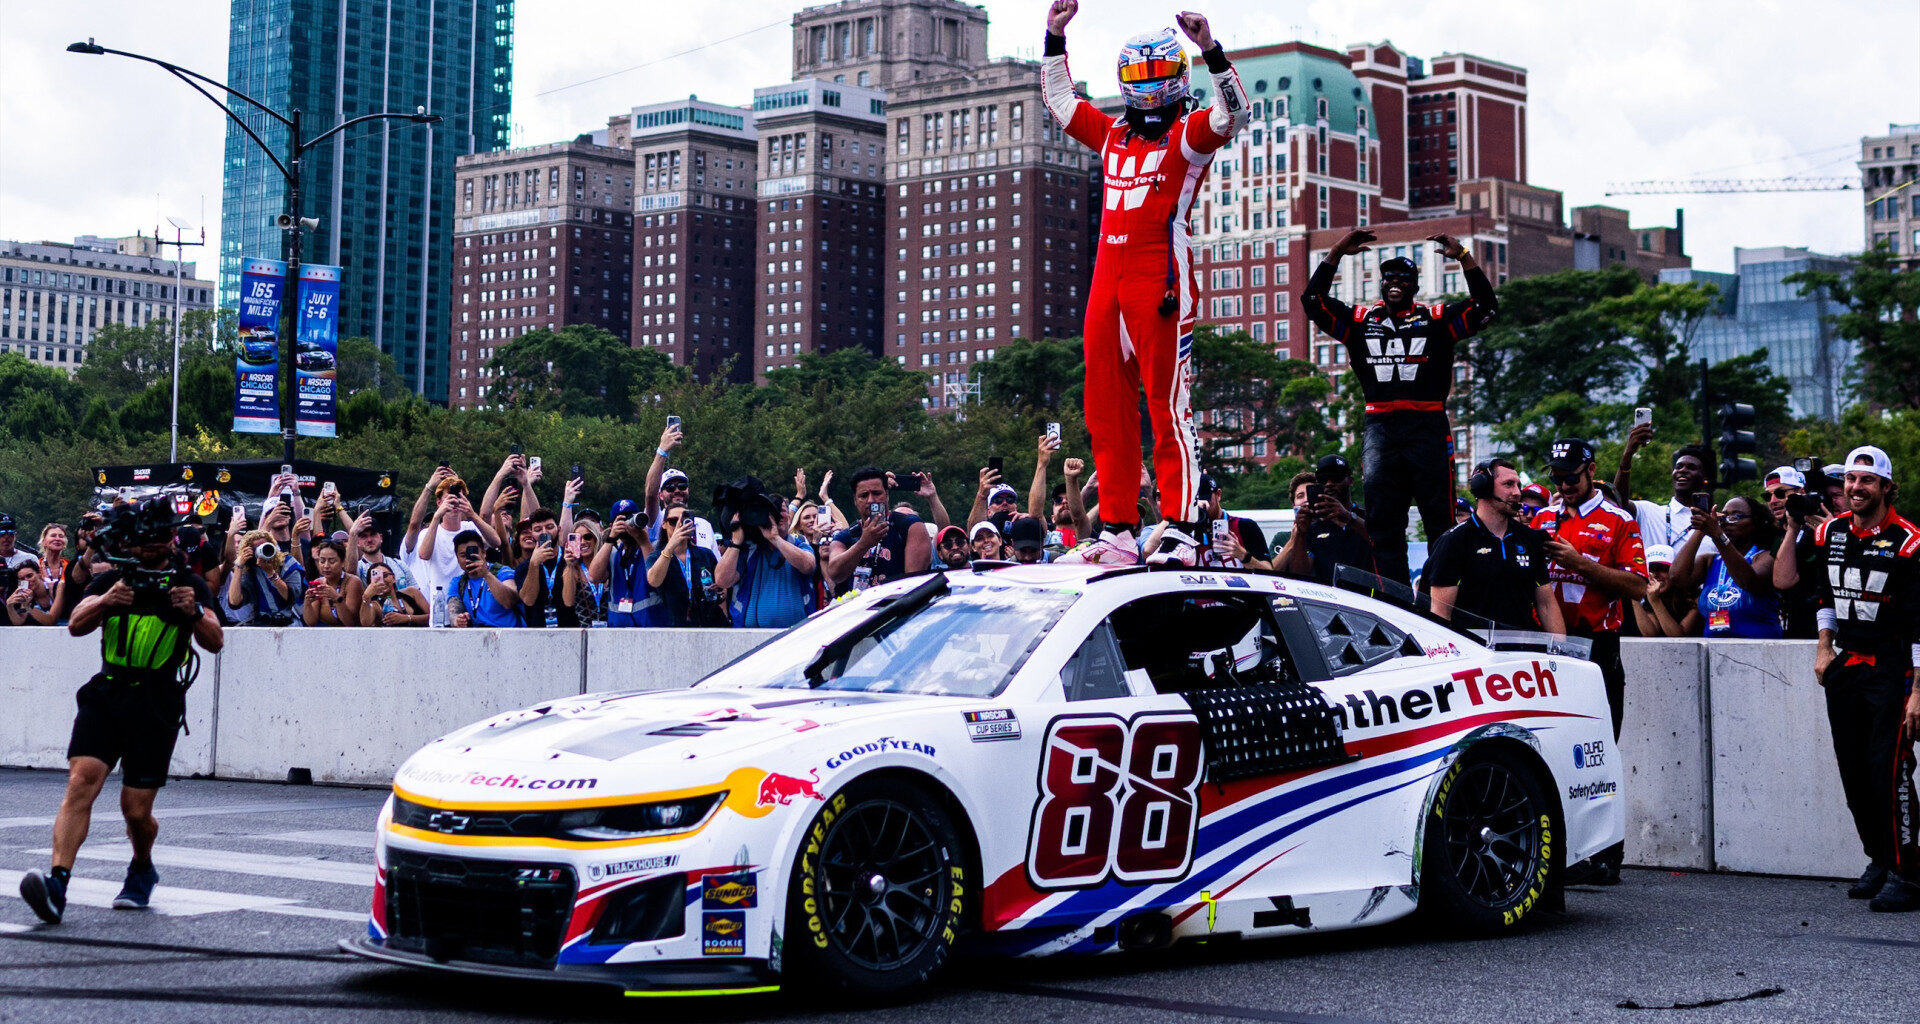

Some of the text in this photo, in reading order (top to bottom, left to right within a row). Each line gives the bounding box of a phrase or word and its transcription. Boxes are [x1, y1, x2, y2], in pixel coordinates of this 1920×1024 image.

[251, 281, 275, 299] 165
[243, 296, 279, 307] MAGNIFICENT
[308, 292, 332, 305] JULY
[247, 304, 273, 317] MILES
[306, 306, 328, 319] 5-6
[249, 373, 274, 383] NASCAR
[307, 378, 332, 387] NASCAR
[240, 380, 274, 390] CHICAGO
[299, 385, 331, 394] CHICAGO
[1297, 587, 1337, 600] SIEMENS
[980, 710, 1008, 720] NASCAR
[976, 723, 1013, 734] CUP SERIES
[826, 737, 936, 769] GOODYEAR
[1583, 740, 1604, 755] QUAD
[1584, 753, 1605, 768] LOCK
[1435, 760, 1463, 819] EAGLE
[1568, 780, 1617, 799] SafetyCulture
[1025, 710, 1206, 893] 88
[608, 856, 669, 875] TRACKHOUSE
[802, 794, 847, 949] GOODYEAR
[1503, 814, 1552, 926] GOODYEAR
[515, 868, 562, 881] ZL1
[706, 885, 757, 900] SUNOCO
[706, 921, 743, 931] SUNOCO
[705, 939, 743, 947] ROOKIE
